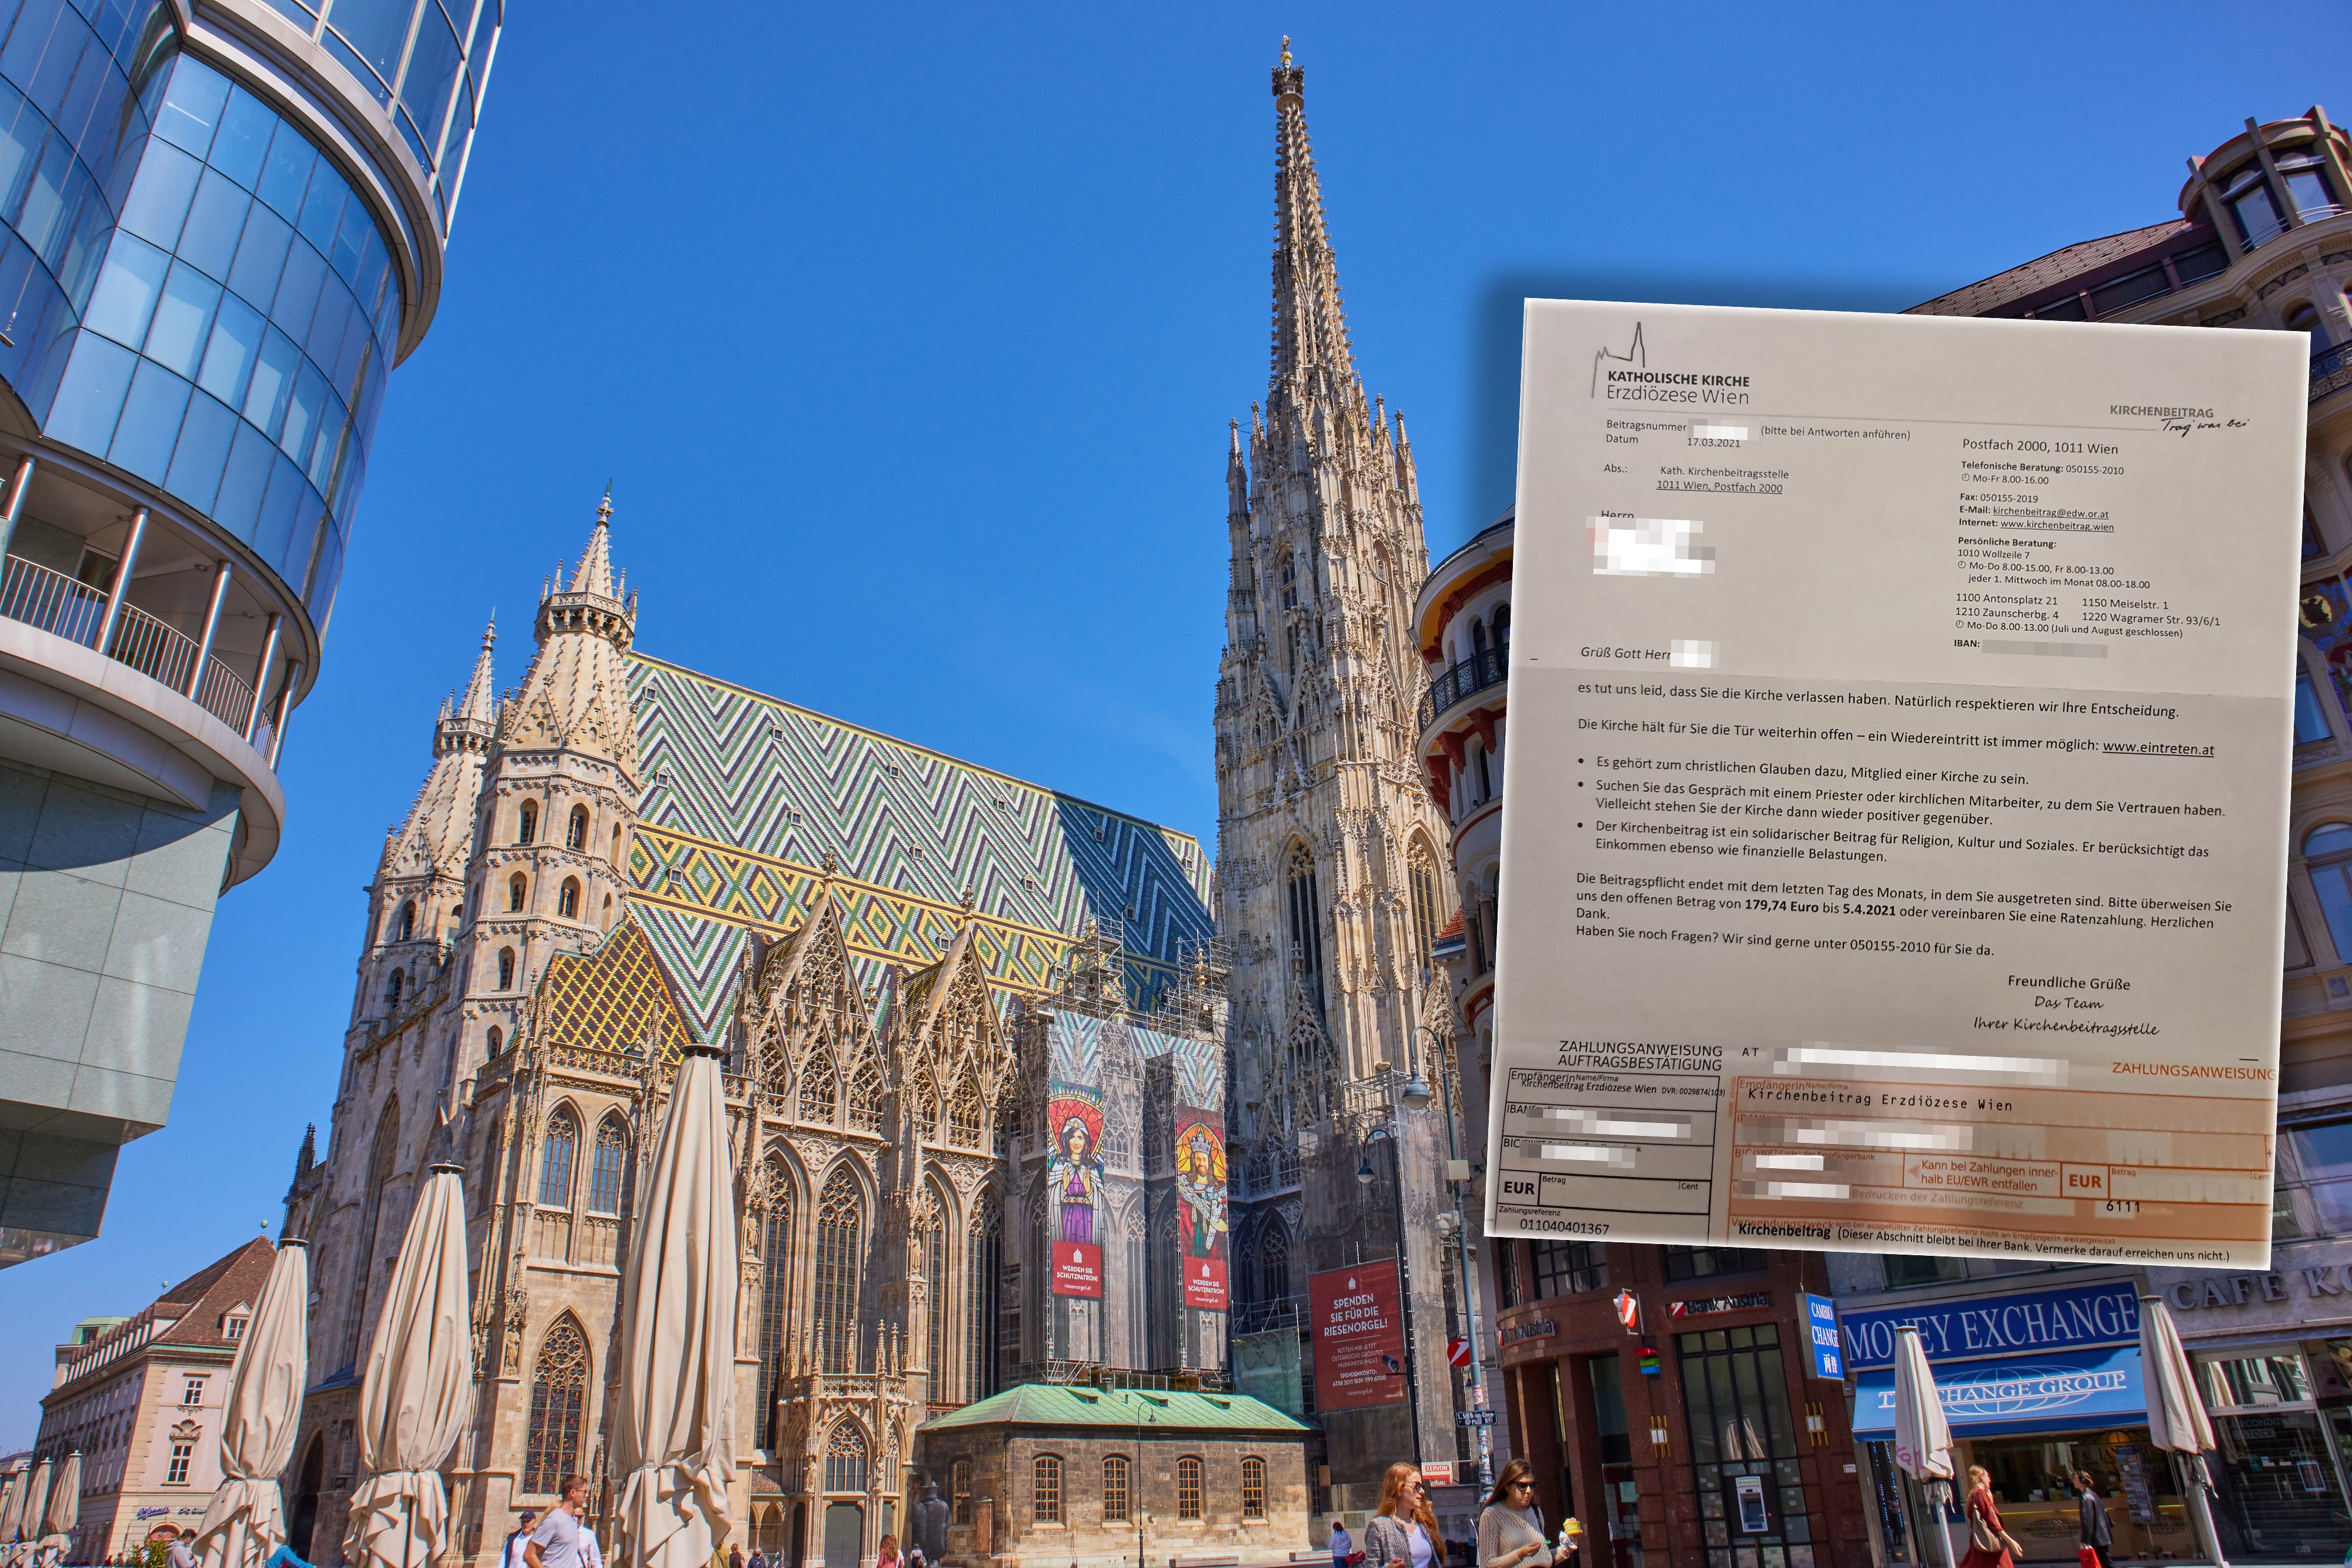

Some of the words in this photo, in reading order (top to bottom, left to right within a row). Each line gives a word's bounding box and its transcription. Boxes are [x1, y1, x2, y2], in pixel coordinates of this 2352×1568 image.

[1609, 371, 1698, 385] KATHOLISCHE
[1702, 375, 1749, 387] KIRCHE
[1608, 385, 1697, 403] Erzdiözese
[1702, 389, 1748, 404] Wien
[2110, 404, 2214, 419] KIRCHENBEITRAG
[1607, 420, 1687, 432] Beitragsnummer
[2227, 418, 2250, 429] bei
[1606, 434, 1638, 443] Datum
[1688, 437, 1740, 447] 17.03.2021
[1963, 439, 2013, 450] Postfach
[2017, 440, 2050, 453] 2000,
[2054, 442, 2083, 453] 1011
[2087, 443, 2117, 454] Wien
[1661, 466, 1685, 475] Kath.
[1689, 467, 1789, 480] Kirchenbeitragsstelle
[1962, 460, 2017, 471] Telefonische
[2020, 463, 2063, 474] Beratung:
[2066, 464, 2124, 474] 050155-2010
[1658, 480, 1680, 489] 1011
[1683, 481, 1710, 490] Wien,
[1715, 482, 1755, 492] Postfach
[1759, 483, 1782, 493] 2000
[1980, 493, 2038, 503] 050155-2019
[1960, 506, 1990, 514] E-Mail:
[1993, 506, 2109, 518] kirchenbeitrag@edw.or.at
[1959, 518, 1997, 527] Internet:
[2001, 520, 2114, 531] www.kirchenbeitrag.wien
[2083, 598, 2107, 607] 1150
[2110, 599, 2159, 609] Meiselstr.
[2164, 601, 2168, 609] 1
[1581, 647, 1611, 658] Grüß
[1615, 648, 1642, 658] Gott
[1645, 649, 1671, 660] Herr
[1579, 684, 1591, 693] es
[1595, 684, 1612, 694] tut
[1616, 686, 1636, 694] uns
[1641, 684, 1665, 698] leid,
[1671, 685, 1696, 697] dass
[1700, 687, 1718, 698] Sie
[1722, 687, 1740, 699] die
[1745, 688, 1782, 701] Kirche
[1786, 691, 1843, 704] verlassen
[1849, 692, 1890, 706] haben.
[1895, 695, 1951, 708] Natürlich
[1956, 698, 2034, 711] respektieren
[2039, 701, 2059, 712] wir
[2063, 701, 2086, 713] Ihre
[2092, 703, 2178, 720] Entscheidung.
[1597, 780, 1639, 791] Suchen
[1643, 782, 1660, 793] Sie
[1665, 783, 1685, 794] das
[1689, 784, 1745, 798] Gespräch
[1750, 787, 1769, 798] mit
[1774, 788, 1811, 800] einem
[1816, 789, 1863, 801] Priester
[1867, 791, 1895, 803] oder
[1899, 791, 1965, 805] kirchlichen
[1970, 795, 2042, 811] Mitarbeiter,
[2047, 801, 2060, 810] zu
[2065, 798, 2092, 811] dem
[2096, 800, 2113, 811] Sie
[2118, 801, 2180, 814] Vertrauen
[2184, 804, 2224, 816] haben.
[1596, 838, 1666, 852] Einkommen
[1671, 841, 1713, 855] ebenso
[1718, 844, 1739, 855] wie
[1743, 844, 1805, 858] finanzielle
[1809, 848, 1886, 864] Belastungen.
[1577, 892, 1597, 901] uns
[1601, 891, 1622, 902] den
[1627, 892, 1672, 905] offenen
[1678, 896, 1715, 910] Betrag
[1719, 900, 1740, 909] von
[1746, 899, 1786, 912] 179,74
[1791, 901, 1819, 912] Euro
[1823, 902, 1839, 914] bis
[1843, 903, 1895, 916] 5.4.2021
[1900, 905, 1928, 917] oder
[1932, 908, 2004, 921] vereinbaren
[2009, 910, 2026, 921] Sie
[2030, 911, 2056, 922] eine
[2061, 912, 2146, 928] Ratenzahlung.
[2151, 916, 2213, 928] Herzlichen
[2009, 975, 2086, 988] Freundliche
[2090, 978, 2130, 990] Grüße
[2035, 996, 2061, 1009] Das
[2064, 997, 2103, 1009] Team
[1975, 1017, 2009, 1029] Ihrer
[2014, 1018, 2160, 1037] Kirchenbeitragsstelle
[1559, 1041, 1722, 1058] ZAHLUNGSANWEISUNG
[1558, 1054, 1721, 1071] AUFTRAGSBESTÄTIGUNG
[2112, 1062, 2276, 1081] ZAHLUNGSANWEISUNG
[1748, 1088, 1871, 1106] Kirchenbeitrag
[1882, 1094, 1967, 1109] Erzdiözese
[1979, 1098, 2012, 1111] Wien
[1542, 1176, 1566, 1185] Betrag
[1504, 1182, 1535, 1196] EUR
[1499, 1206, 1561, 1217] Zahlungsreferenz
[2107, 1202, 2139, 1213] 6111
[1520, 1218, 1609, 1235] 011040401367
[1057, 1272, 1098, 1282] SCHUTZPATRON!
[1188, 1285, 1225, 1295] SCHUTZPATRON!
[2169, 1268, 2288, 1310] CAFÉ
[1334, 1293, 1374, 1309] SPENDEN
[1685, 1297, 1720, 1314] Bank
[1723, 1293, 1768, 1310] Austria
[1331, 1312, 1343, 1323] SIE
[1345, 1308, 1362, 1320] FÜR
[1364, 1306, 1379, 1318] DIE
[1811, 1302, 1833, 1321] CAMBIO
[1324, 1318, 1388, 1338] RIESENORGEL!
[1958, 1293, 2141, 1350] EXCHANGE
[1812, 1326, 1839, 1348] CHANGE
[1331, 1353, 1360, 1362] ÖSTERREICHS
[1338, 1358, 1378, 1368] MUSIKINSTRUMENT
[1340, 1369, 1377, 1379] SPENDENKONTO:
[2039, 1373, 2126, 1393] GROUP
[1347, 1388, 1373, 1396] riesenorgel.at
